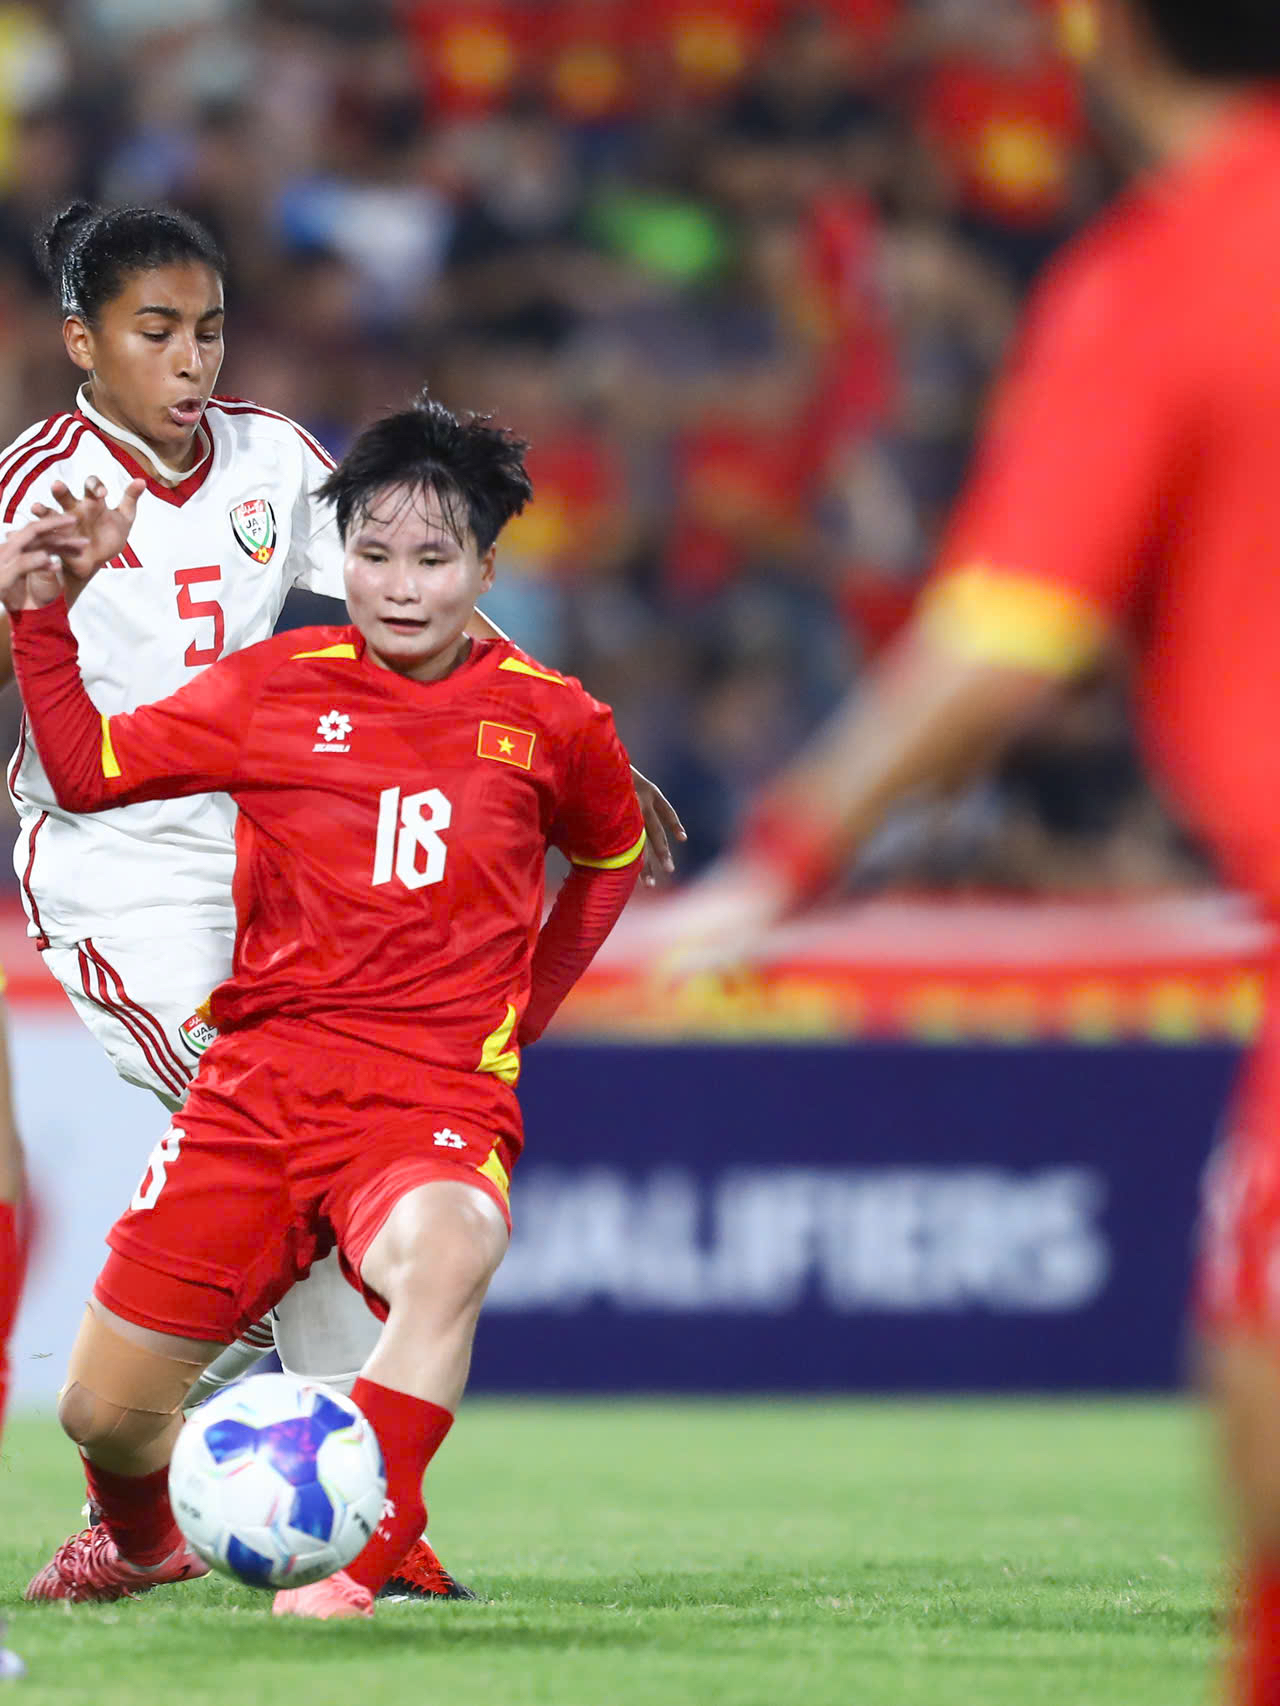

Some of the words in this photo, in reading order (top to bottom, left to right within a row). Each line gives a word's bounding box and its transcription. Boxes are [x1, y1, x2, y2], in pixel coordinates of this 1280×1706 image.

[174, 564, 225, 668] 5
[371, 785, 453, 891] 18
[131, 1124, 186, 1211] 8
[482, 1167, 1108, 1311] UALIFIERS
